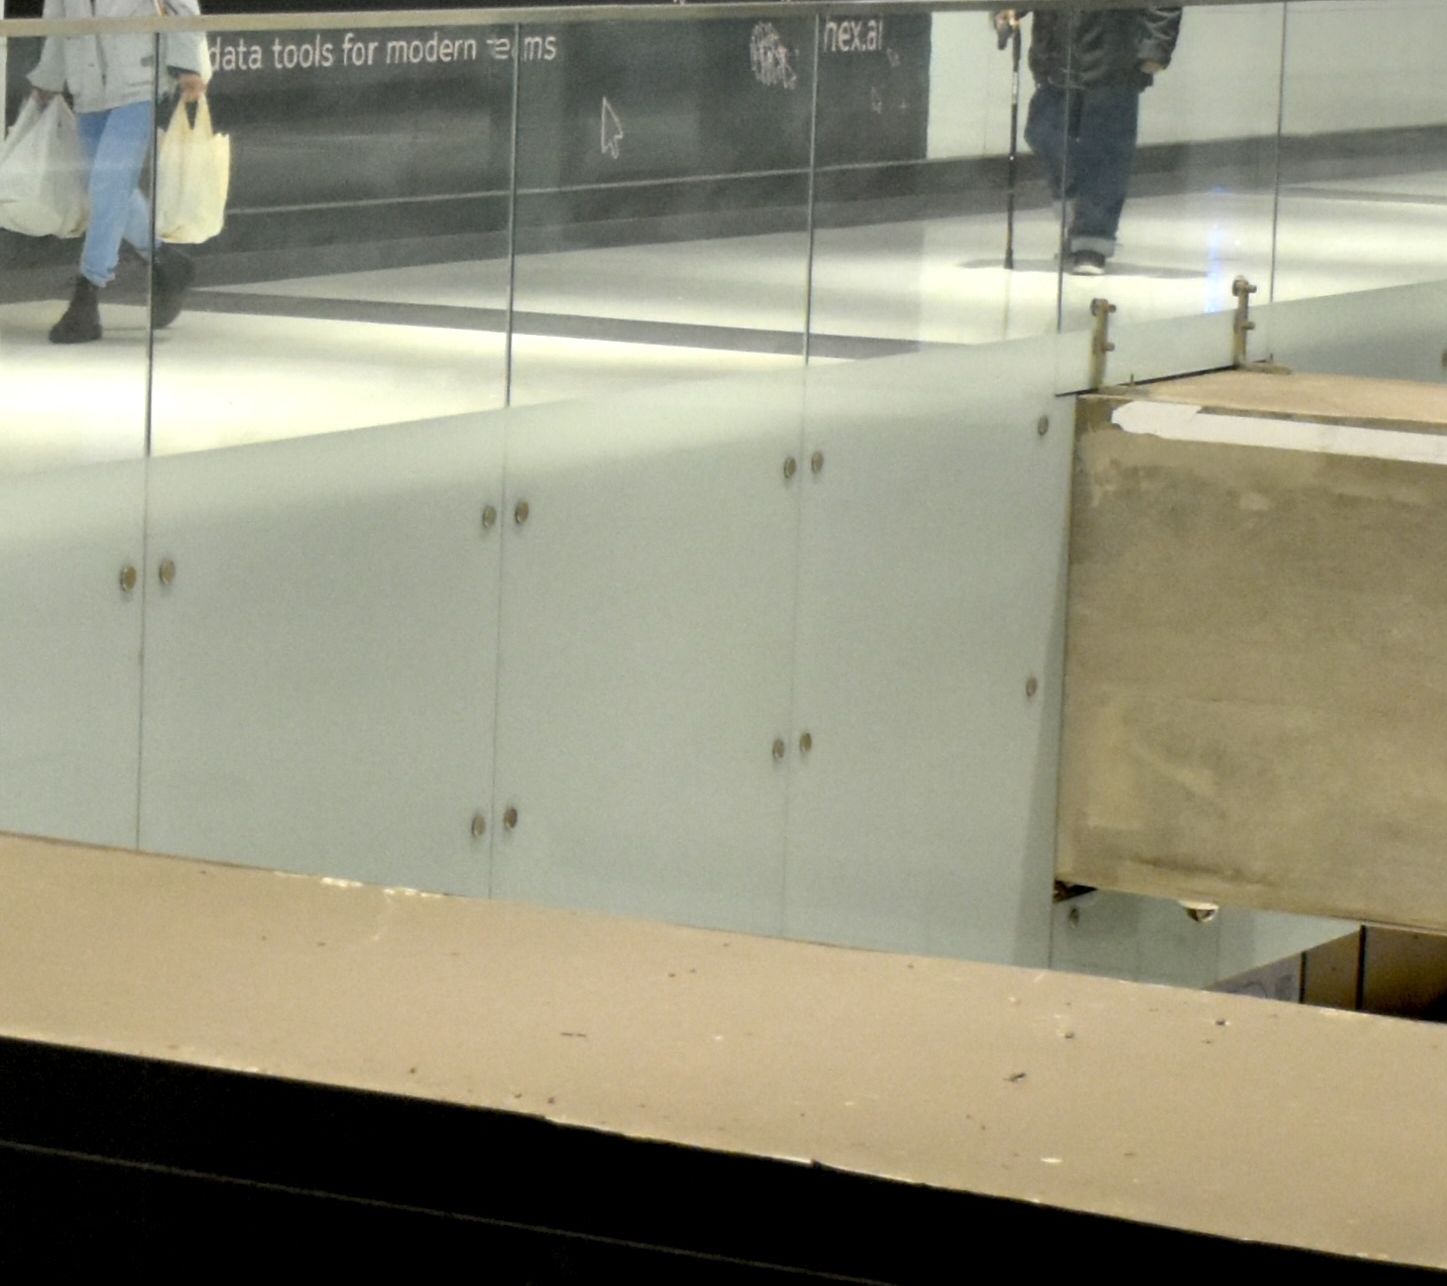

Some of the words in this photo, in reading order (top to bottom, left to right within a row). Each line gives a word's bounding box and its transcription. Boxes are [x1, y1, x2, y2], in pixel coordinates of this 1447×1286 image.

[208, 36, 262, 71] data
[272, 34, 333, 69] tools
[342, 33, 378, 65] for
[386, 31, 477, 65] modern
